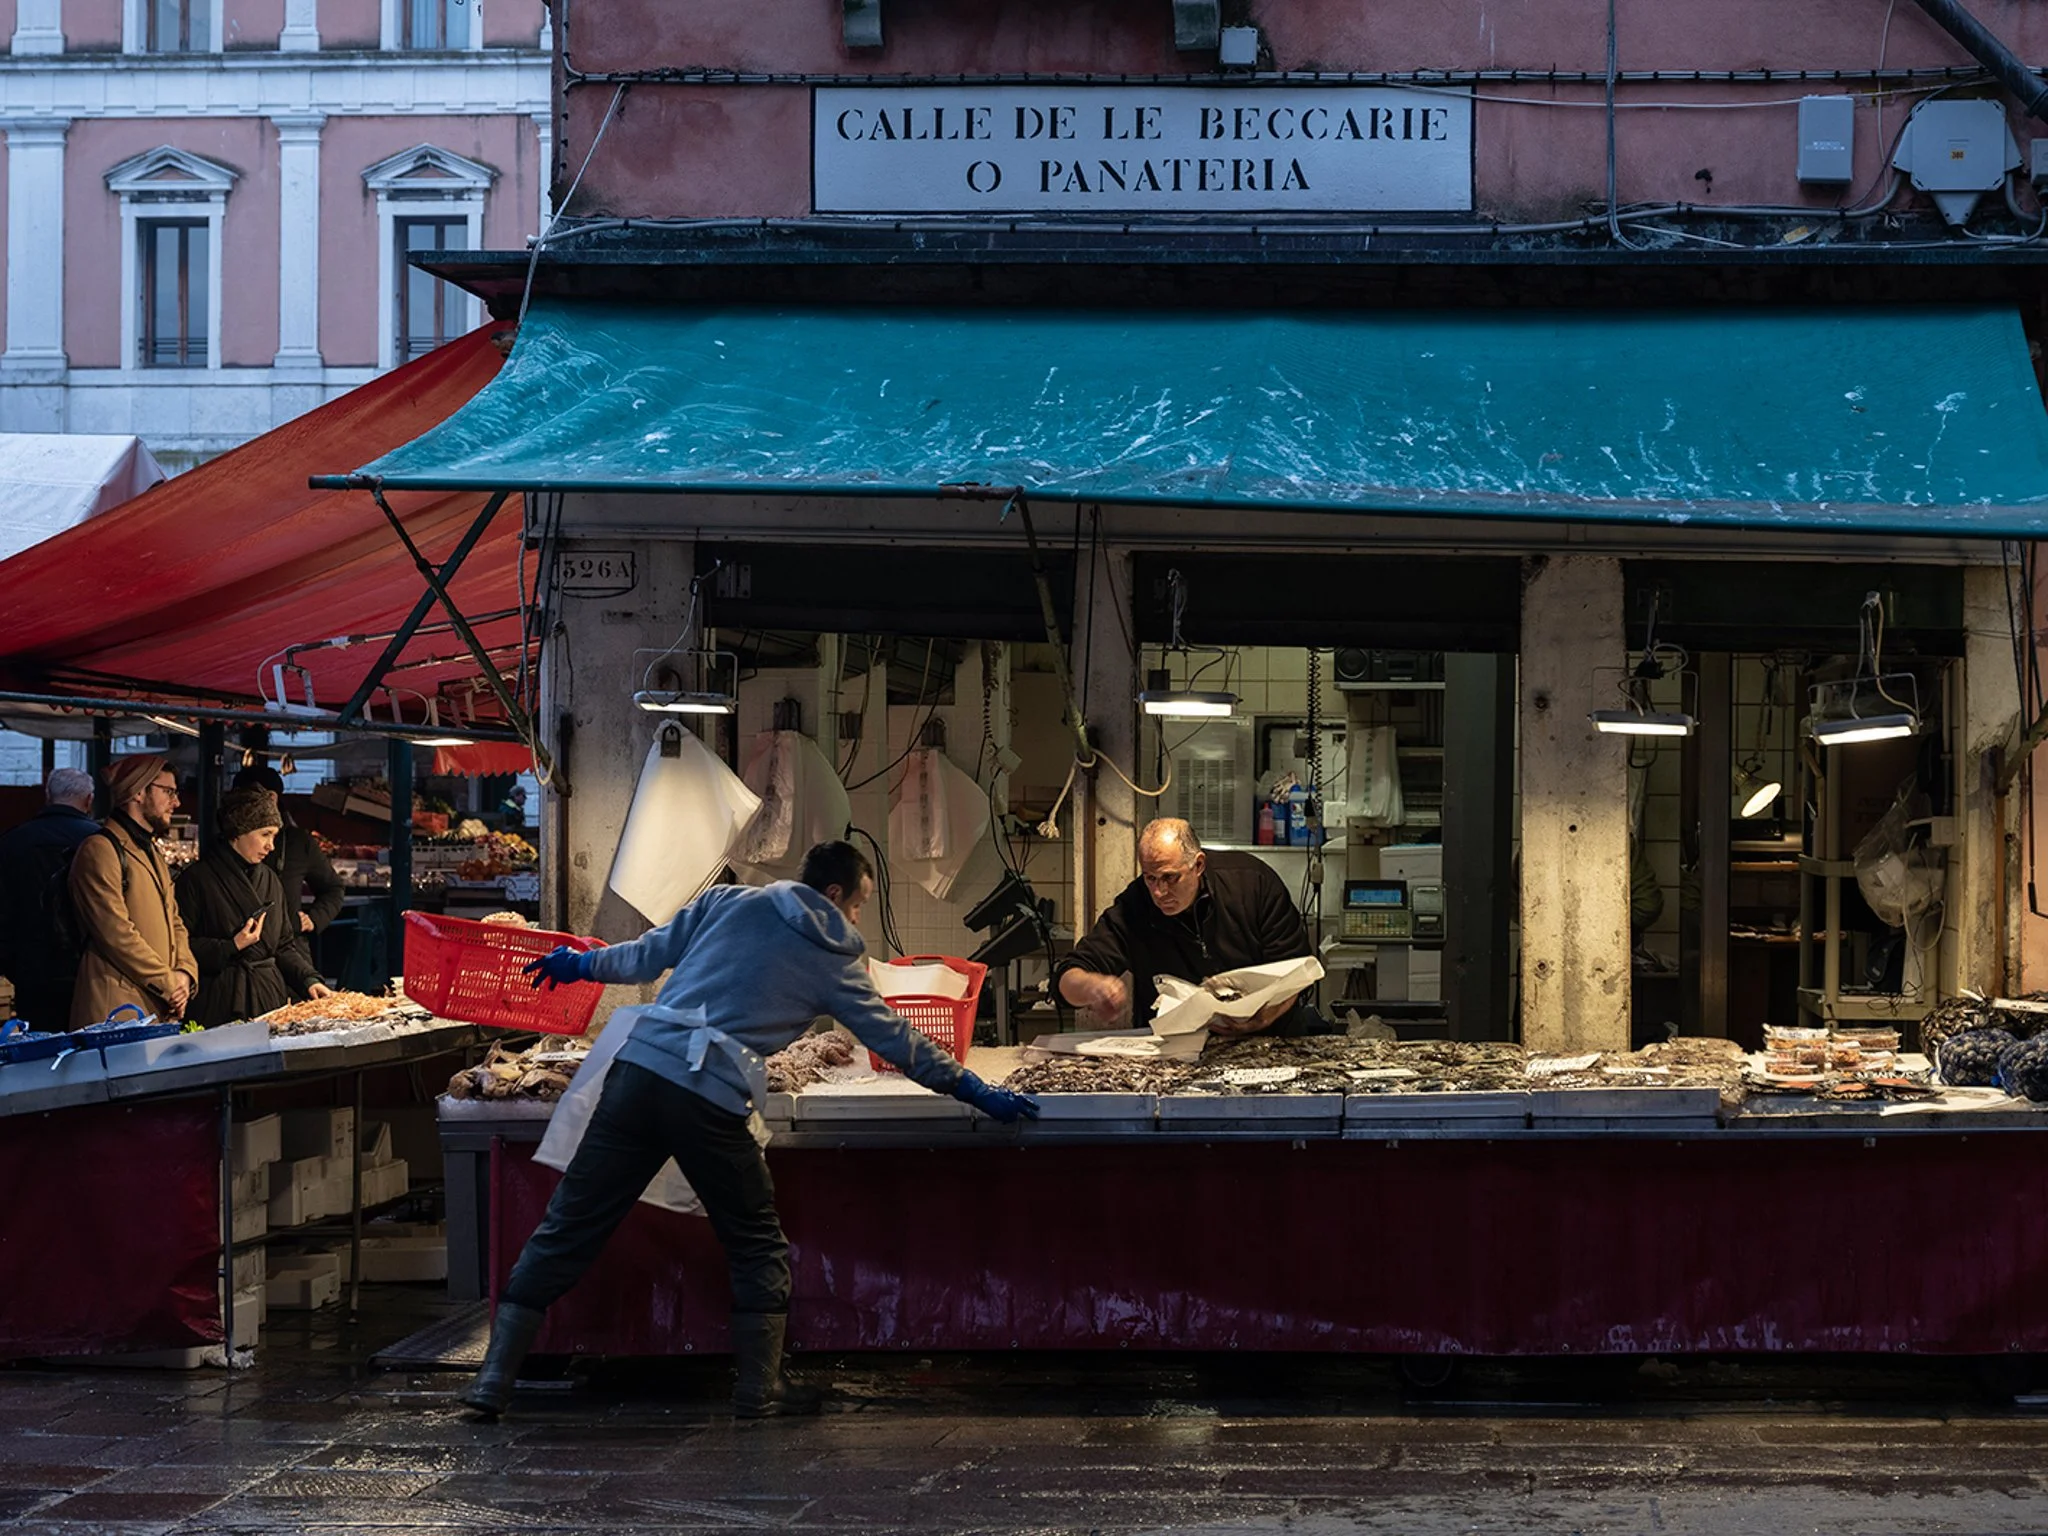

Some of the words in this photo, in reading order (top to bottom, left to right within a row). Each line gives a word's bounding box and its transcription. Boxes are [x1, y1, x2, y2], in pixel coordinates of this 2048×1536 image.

[837, 107, 992, 141] CALLE
[1015, 106, 1076, 140] DE
[1102, 106, 1162, 140] LE
[1199, 107, 1448, 141] BECCARIE
[966, 160, 1002, 193] O
[1039, 157, 1311, 193] PANATERIA
